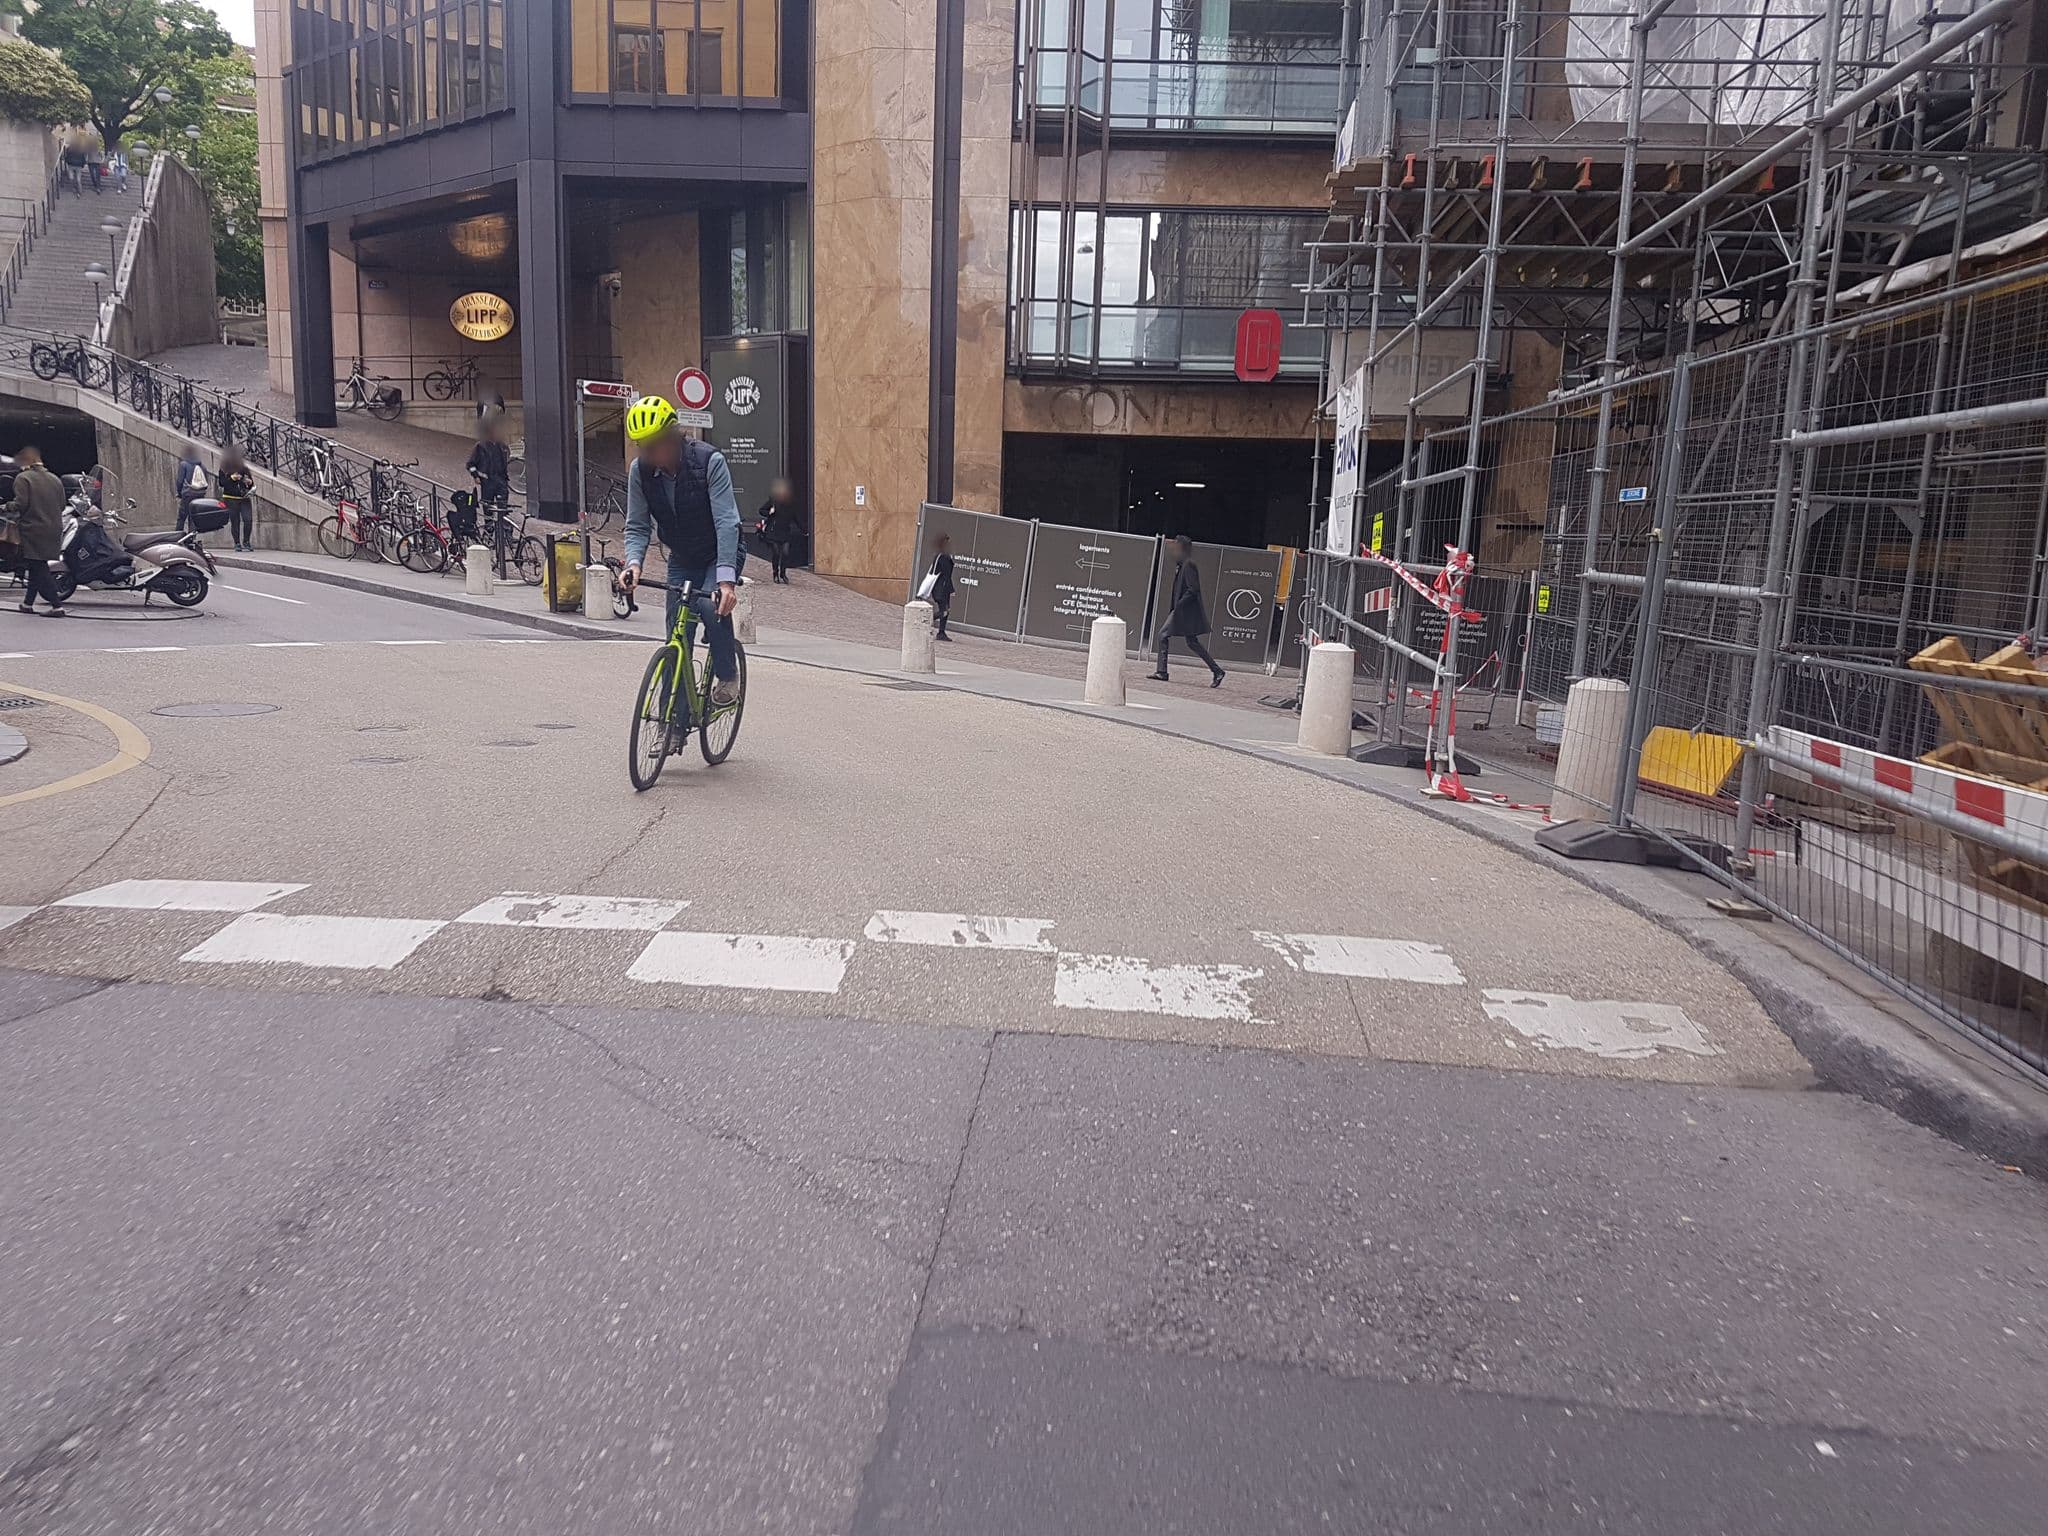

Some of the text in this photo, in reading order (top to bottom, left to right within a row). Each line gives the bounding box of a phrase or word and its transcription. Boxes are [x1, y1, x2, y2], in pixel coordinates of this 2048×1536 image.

[461, 295, 501, 309] BRASSERIE
[467, 309, 497, 324] LIPP
[462, 325, 503, 338] RESTAURANT
[732, 388, 752, 404] LIPP
[1079, 544, 1110, 553] logements
[954, 554, 976, 563] univers
[1055, 583, 1075, 592] entrée
[1075, 586, 1116, 598] confédération
[1079, 594, 1104, 603] bureaux
[1053, 605, 1077, 615] Integral
[1062, 599, 1076, 607] CFE
[1076, 600, 1099, 610] (Suisse)
[1222, 630, 1257, 640] CENTRE
